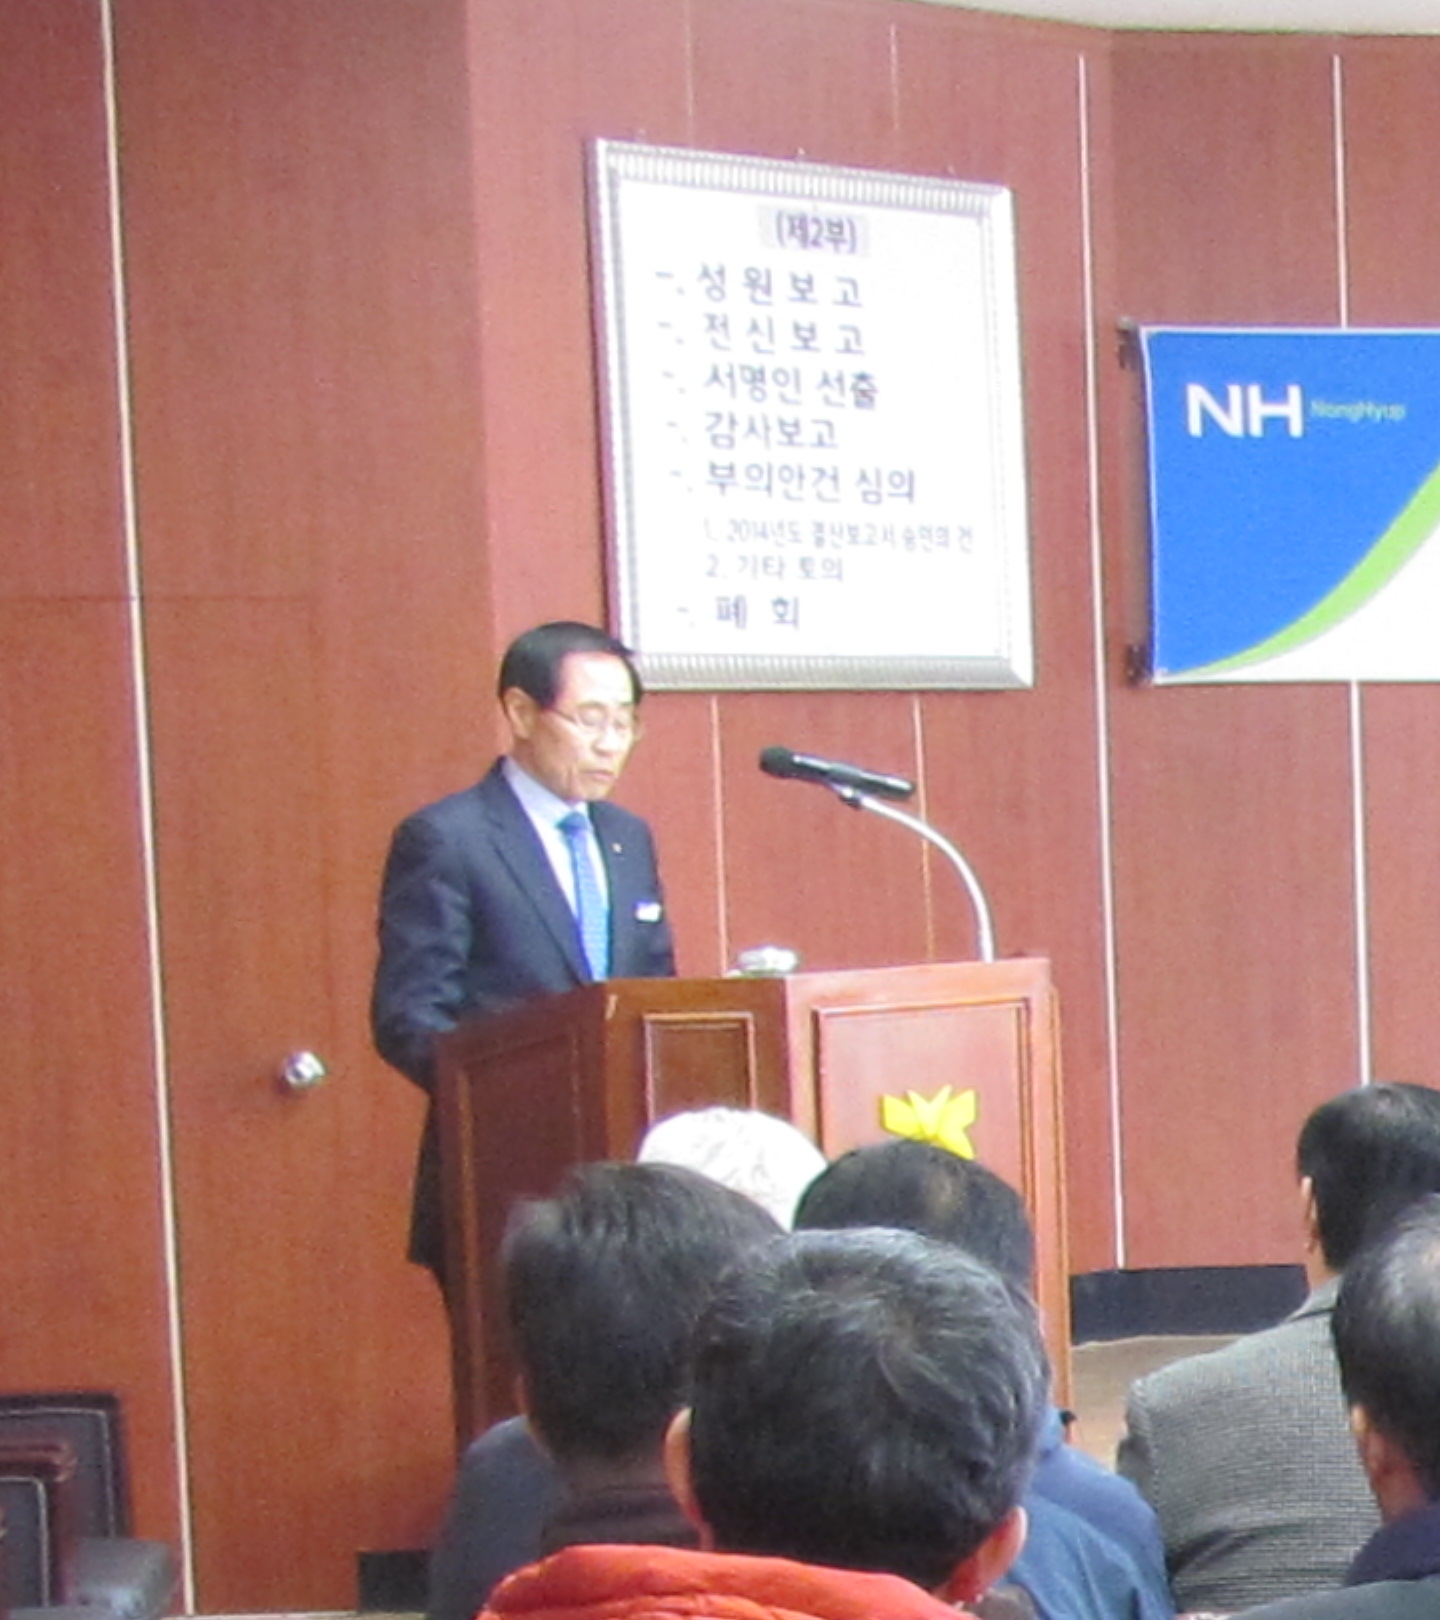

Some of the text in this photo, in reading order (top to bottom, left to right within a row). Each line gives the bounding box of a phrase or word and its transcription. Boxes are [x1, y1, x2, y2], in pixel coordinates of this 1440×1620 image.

[776, 213, 858, 254] (제2부)
[705, 364, 880, 410] 서명인 선출
[705, 411, 839, 451] 감사보고
[1187, 383, 1305, 439] NH
[706, 462, 917, 506] 부의안건 심의
